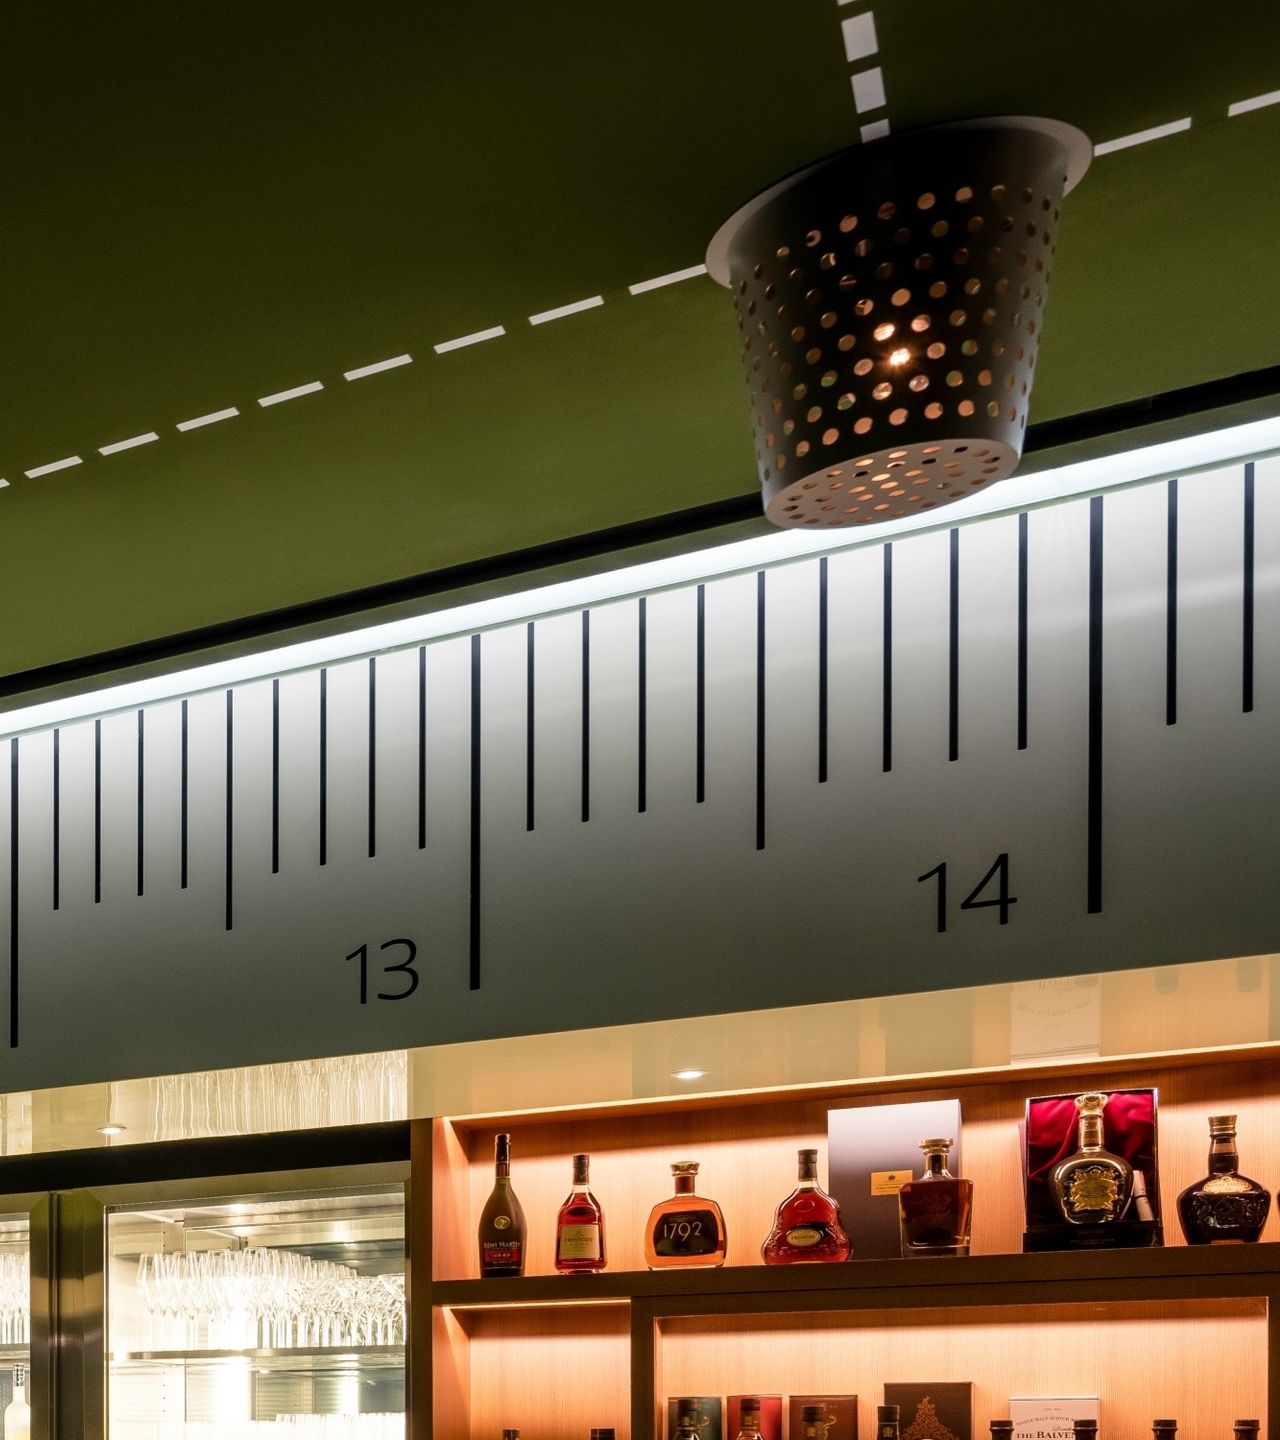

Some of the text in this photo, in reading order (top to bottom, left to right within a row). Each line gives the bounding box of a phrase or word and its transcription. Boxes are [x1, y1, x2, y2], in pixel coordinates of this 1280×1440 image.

[917, 853, 1018, 934] 14
[344, 938, 419, 1005] 13
[663, 1221, 703, 1242] 1792
[1036, 1431, 1076, 1439] BALVEN
